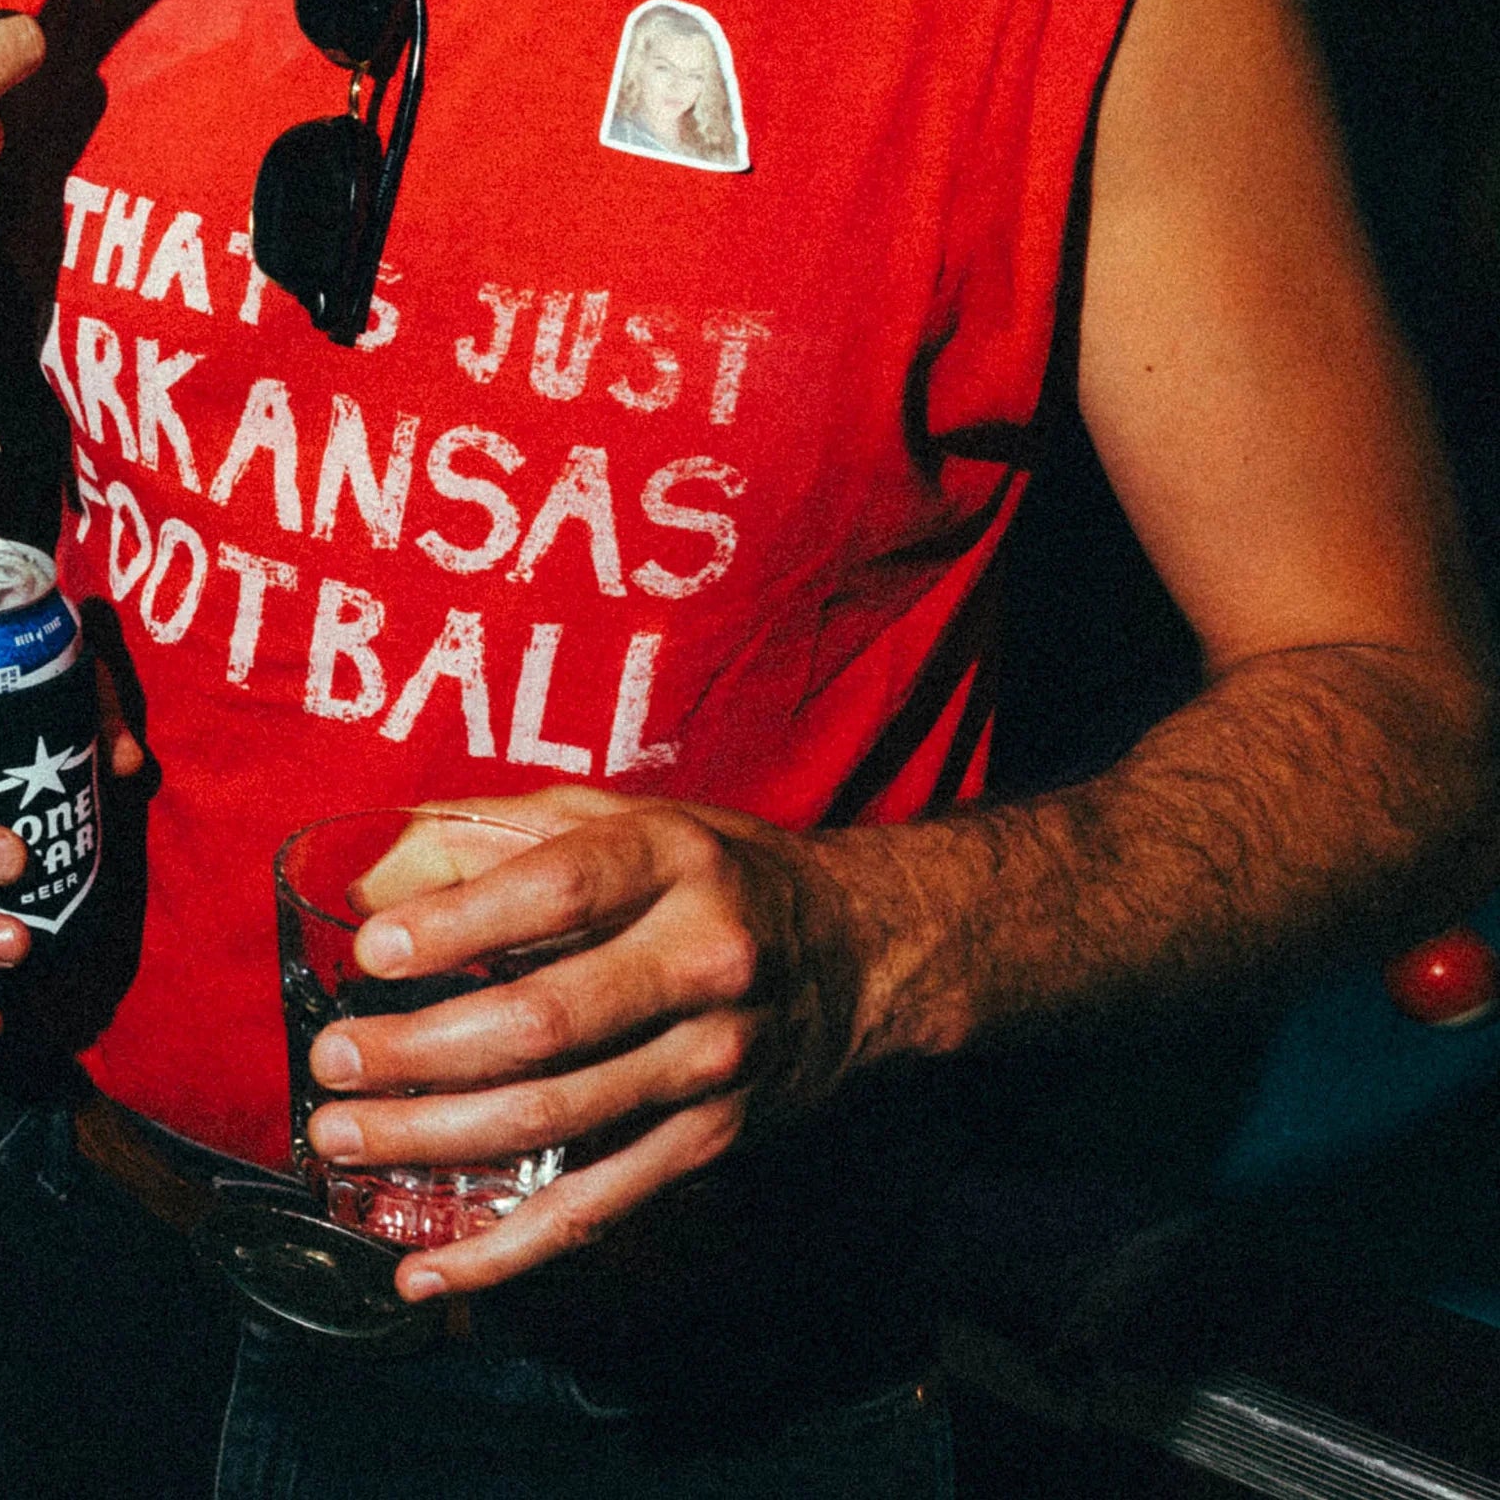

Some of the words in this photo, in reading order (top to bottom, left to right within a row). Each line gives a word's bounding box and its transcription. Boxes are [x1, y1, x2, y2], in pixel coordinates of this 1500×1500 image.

[62, 175, 402, 353] THATS
[455, 281, 773, 425] JUST
[11, 785, 93, 846] ONE
[35, 823, 94, 875] AR
